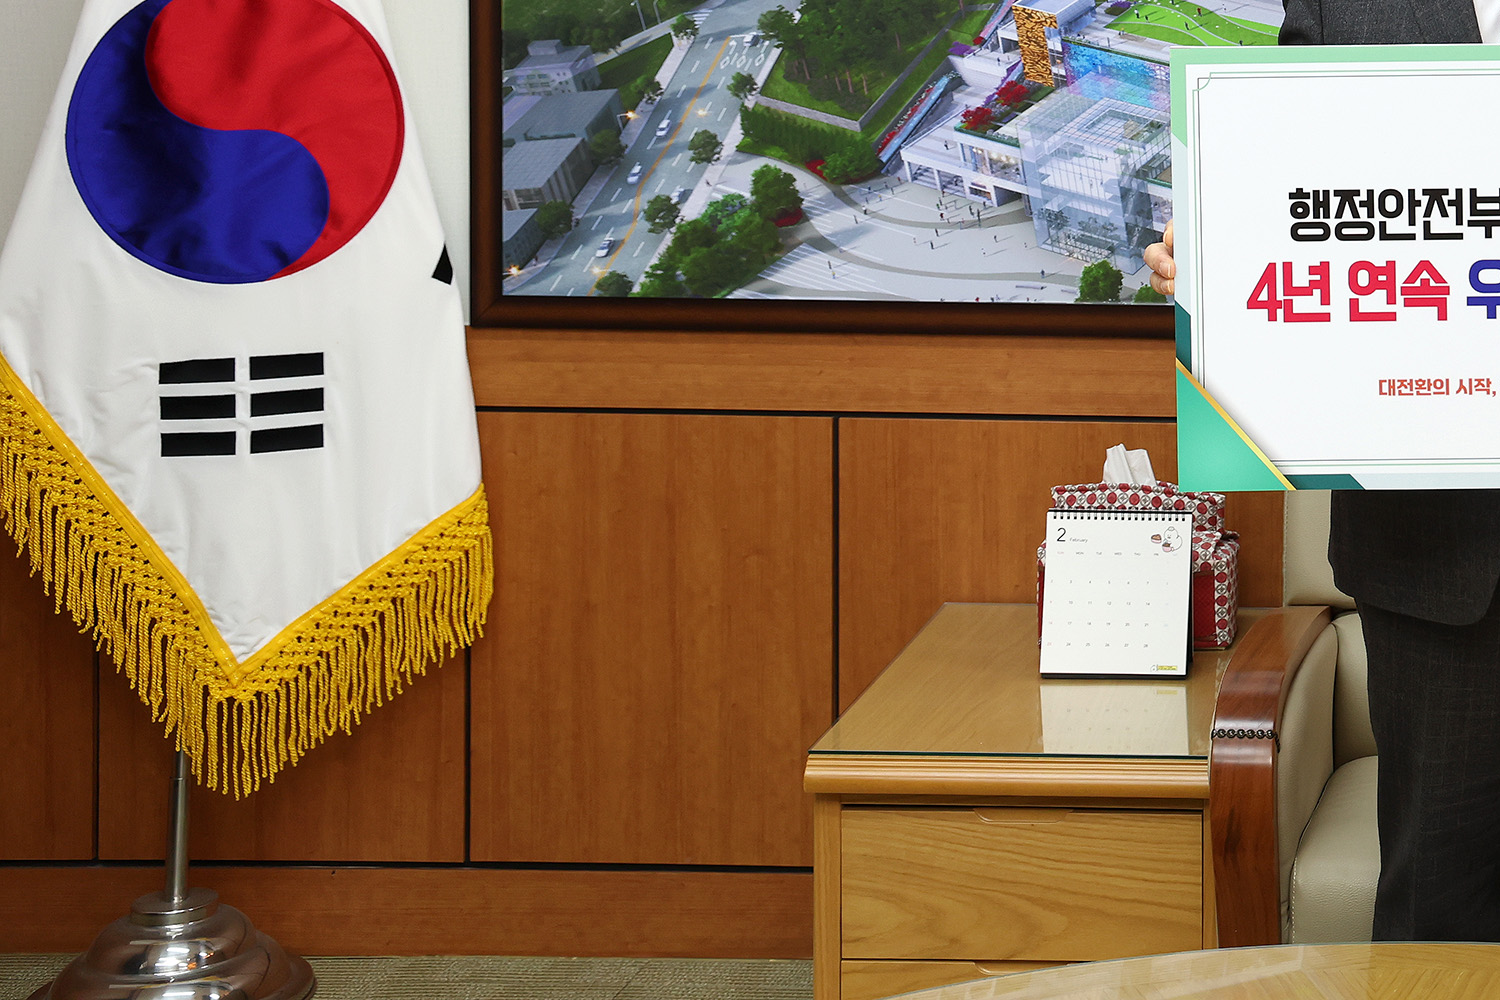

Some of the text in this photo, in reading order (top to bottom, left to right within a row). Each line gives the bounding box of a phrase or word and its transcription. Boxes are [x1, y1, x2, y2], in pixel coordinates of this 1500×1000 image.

[1246, 260, 1331, 323] 4년
[1347, 259, 1451, 323] 연속
[1378, 378, 1450, 397] 대전환의
[1455, 377, 1497, 398] 시작,
[1056, 527, 1067, 542] 2
